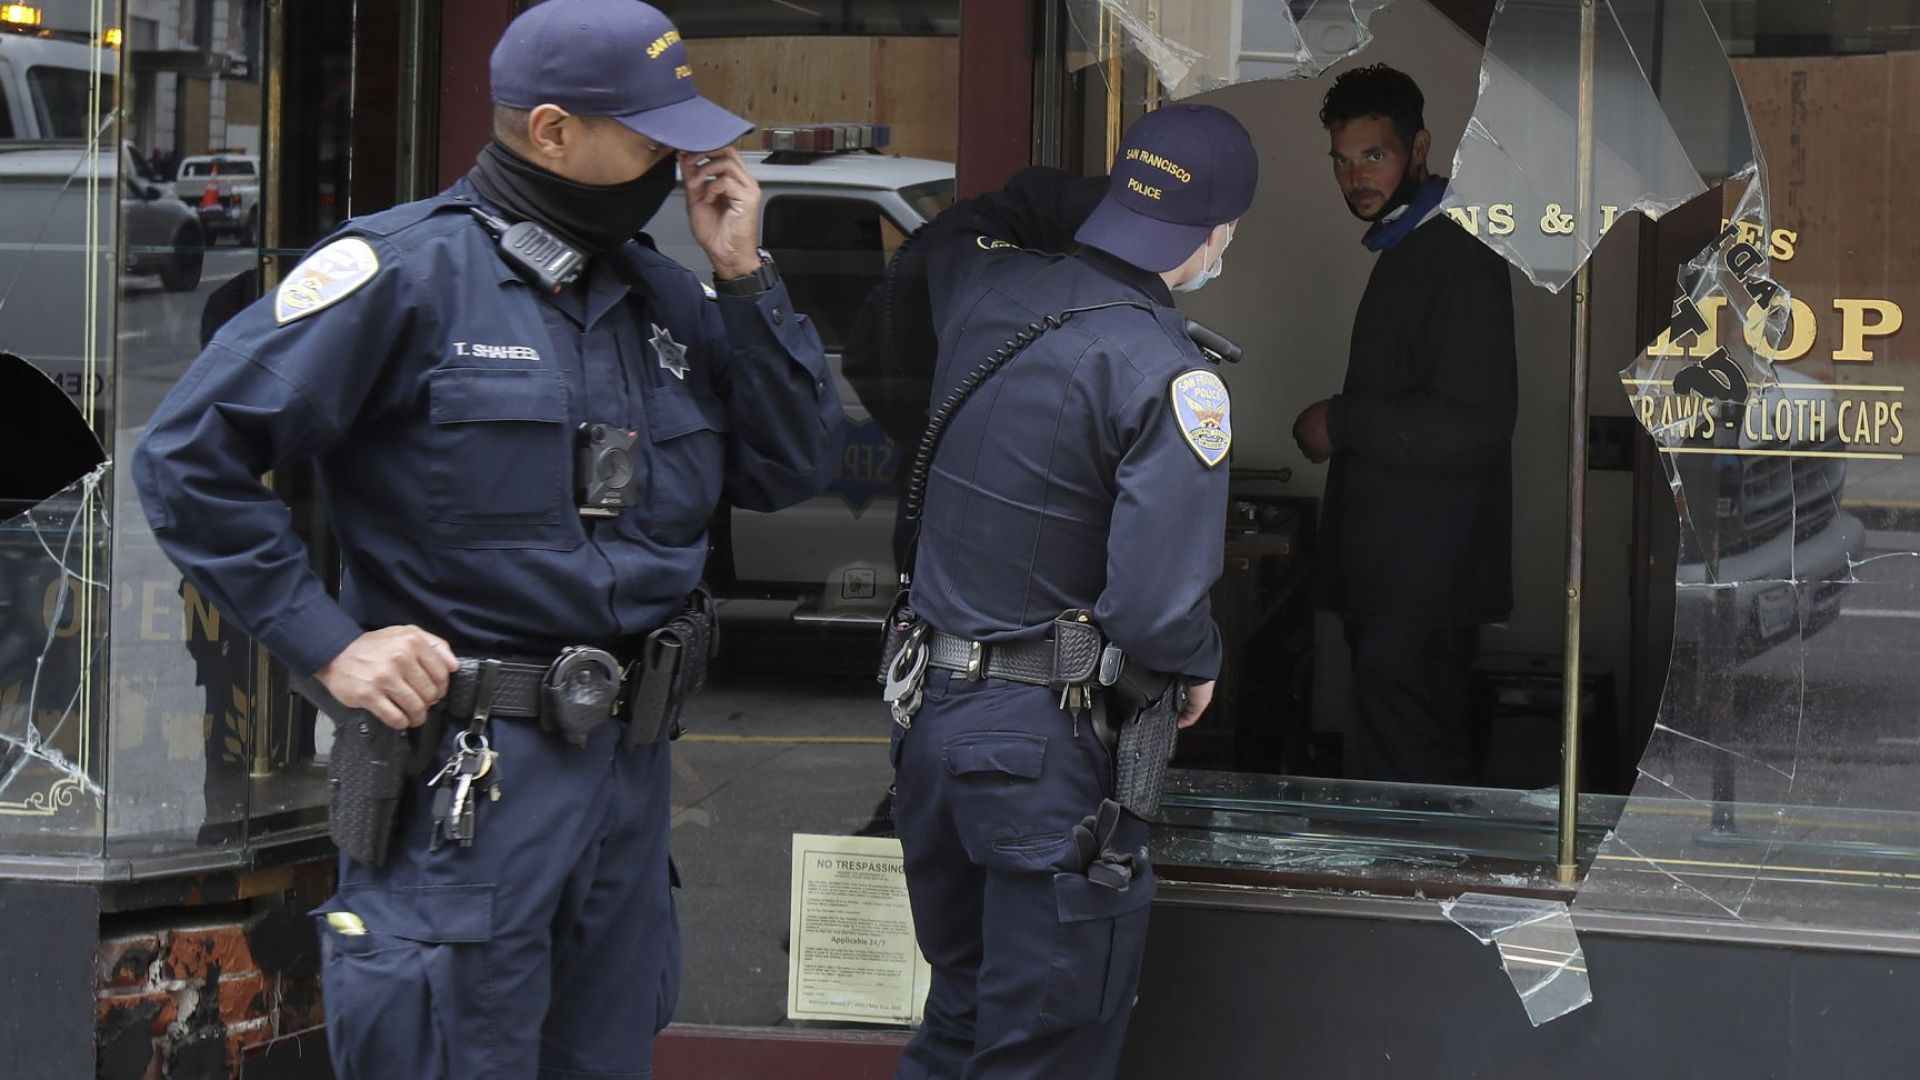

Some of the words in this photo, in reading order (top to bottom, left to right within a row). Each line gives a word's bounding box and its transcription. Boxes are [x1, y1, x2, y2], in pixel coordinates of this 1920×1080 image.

[1126, 148, 1140, 160] SAN
[1139, 150, 1191, 183] FRANCISCO
[1127, 178, 1162, 200] POLICE
[1540, 203, 1574, 235] &
[452, 342, 470, 356] T.
[1629, 394, 1715, 440] RAWS
[1745, 398, 1827, 443] CLOTH
[1838, 400, 1904, 446] CAPS
[42, 577, 220, 641] OPEN
[817, 859, 832, 869] NO
[836, 860, 905, 874] TRESPASSING
[831, 936, 867, 946] Applicable
